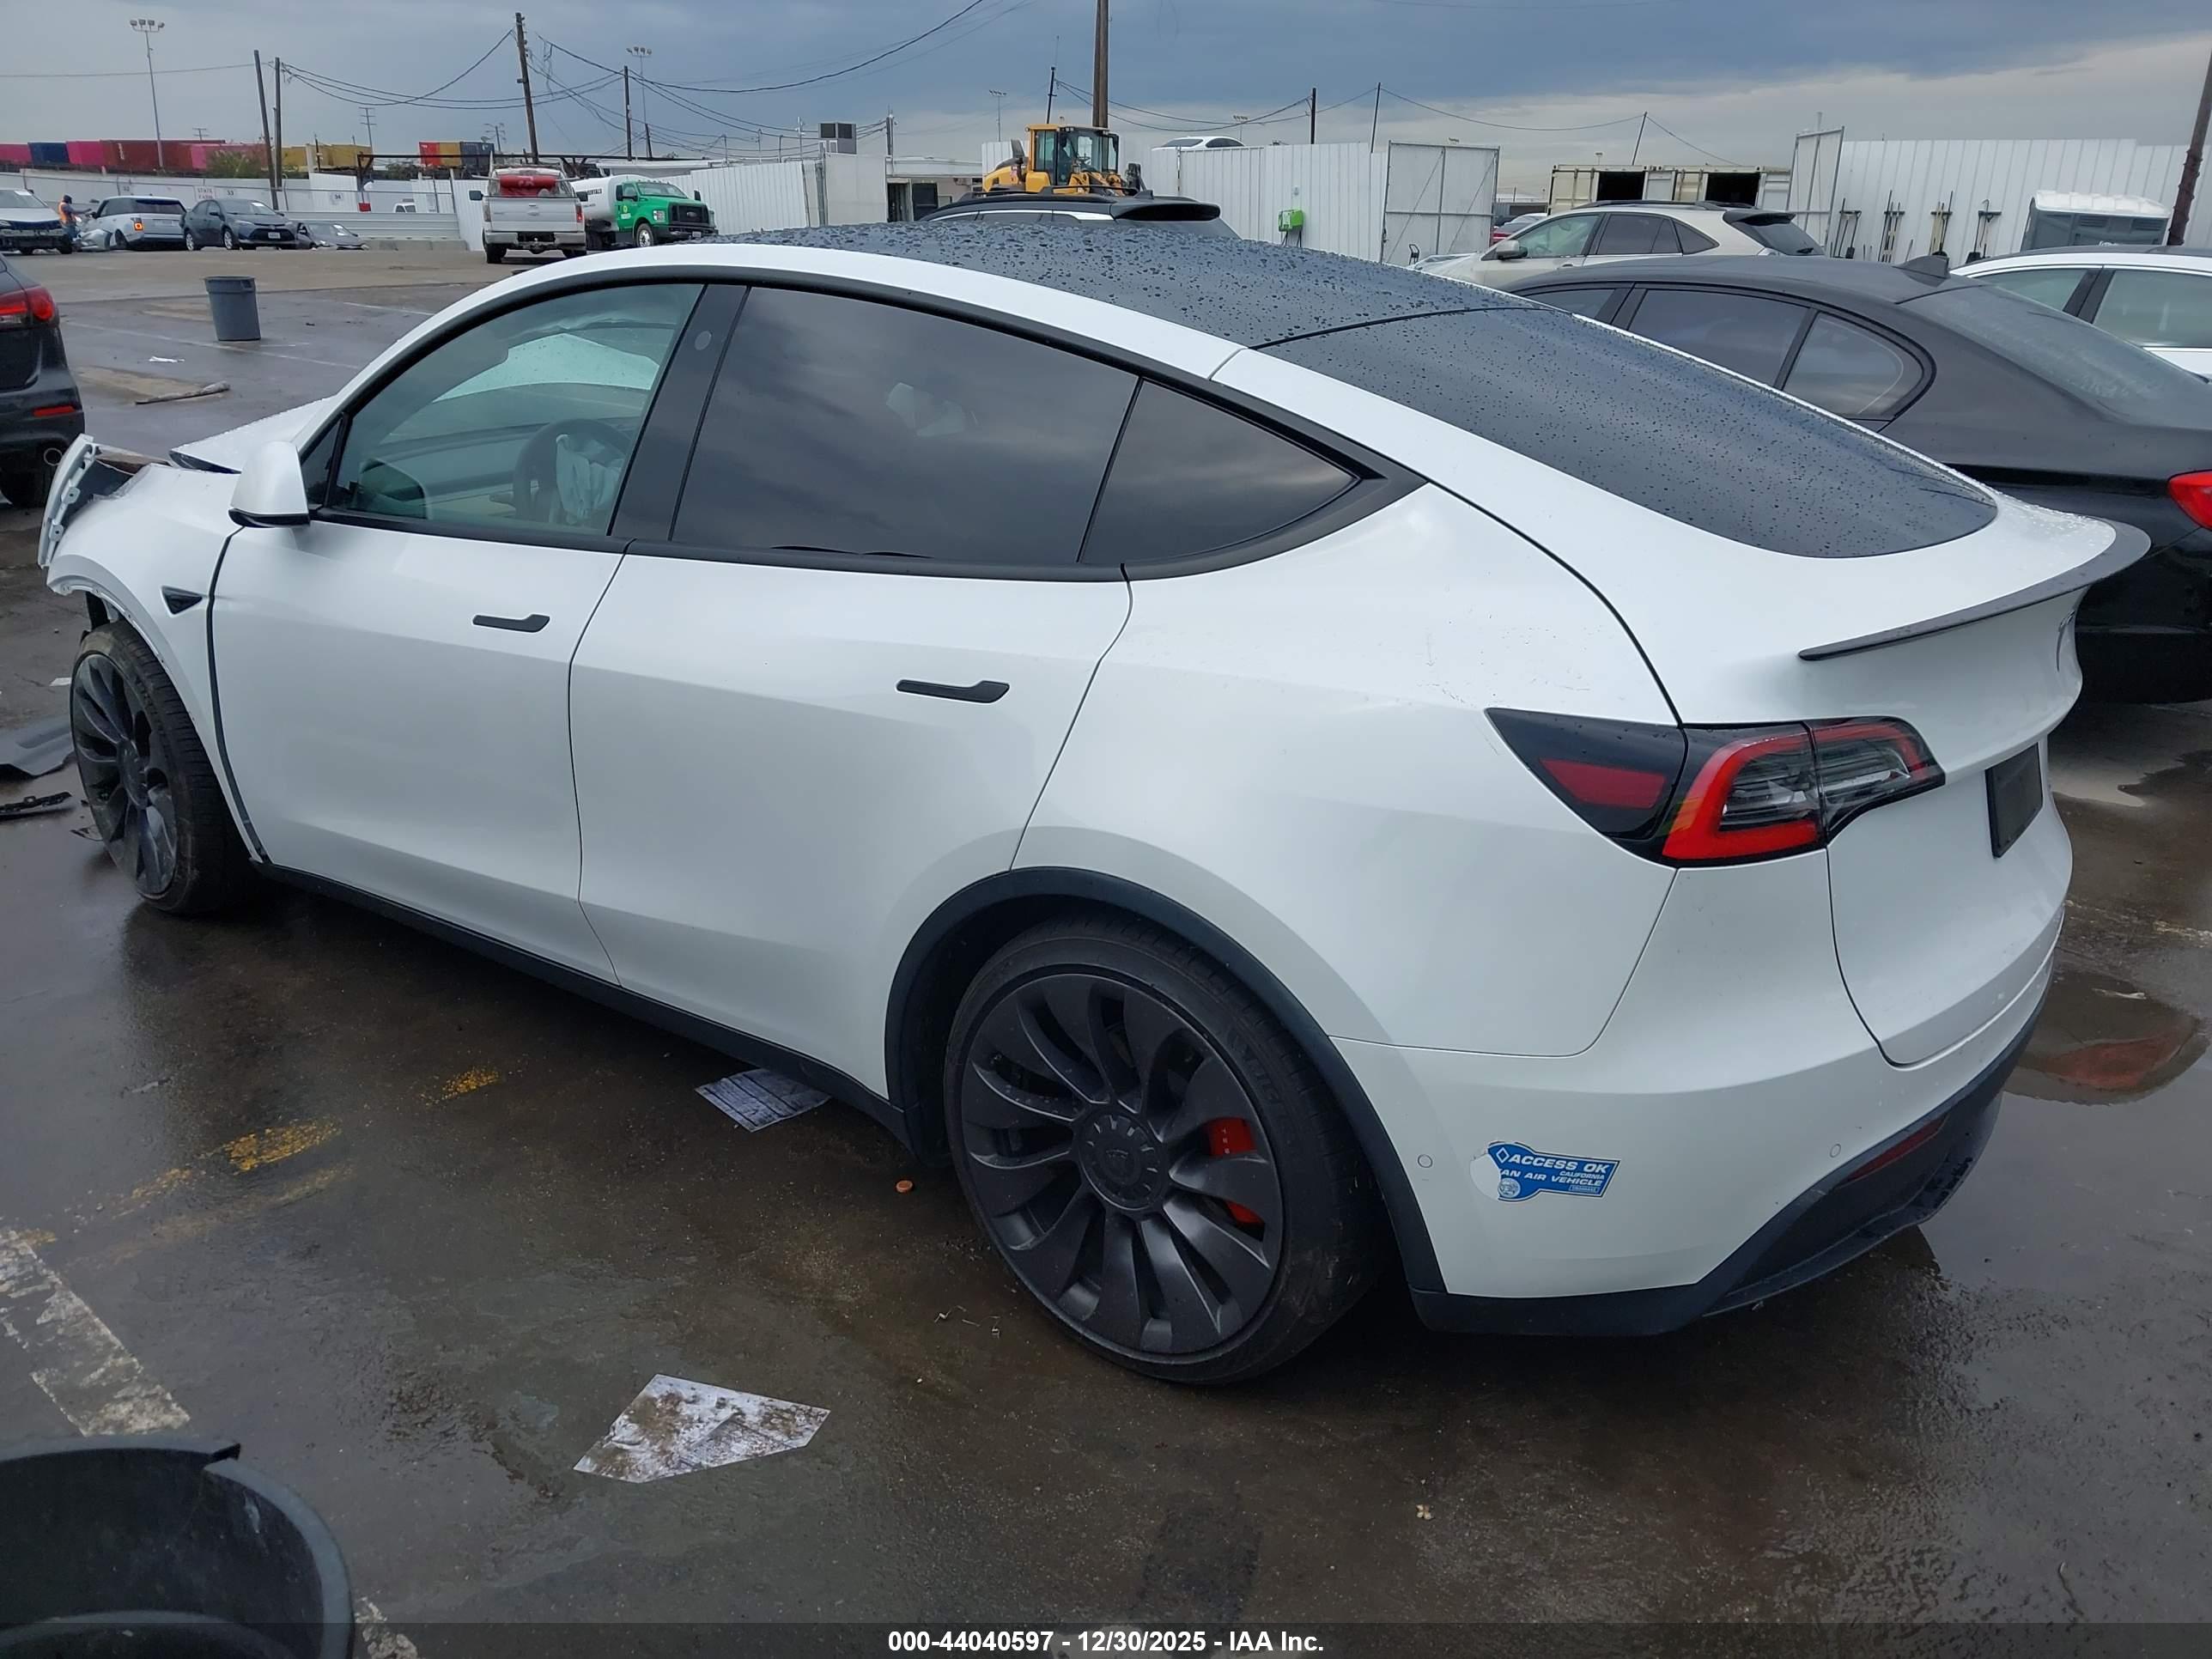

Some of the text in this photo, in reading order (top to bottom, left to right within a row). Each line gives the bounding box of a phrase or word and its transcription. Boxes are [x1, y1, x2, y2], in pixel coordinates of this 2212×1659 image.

[1509, 1153, 1610, 1174] ACCESS OK
[1499, 1168, 1602, 1186] AN AIR VEHICLE
[1559, 1170, 1604, 1180] CALIFORNIA
